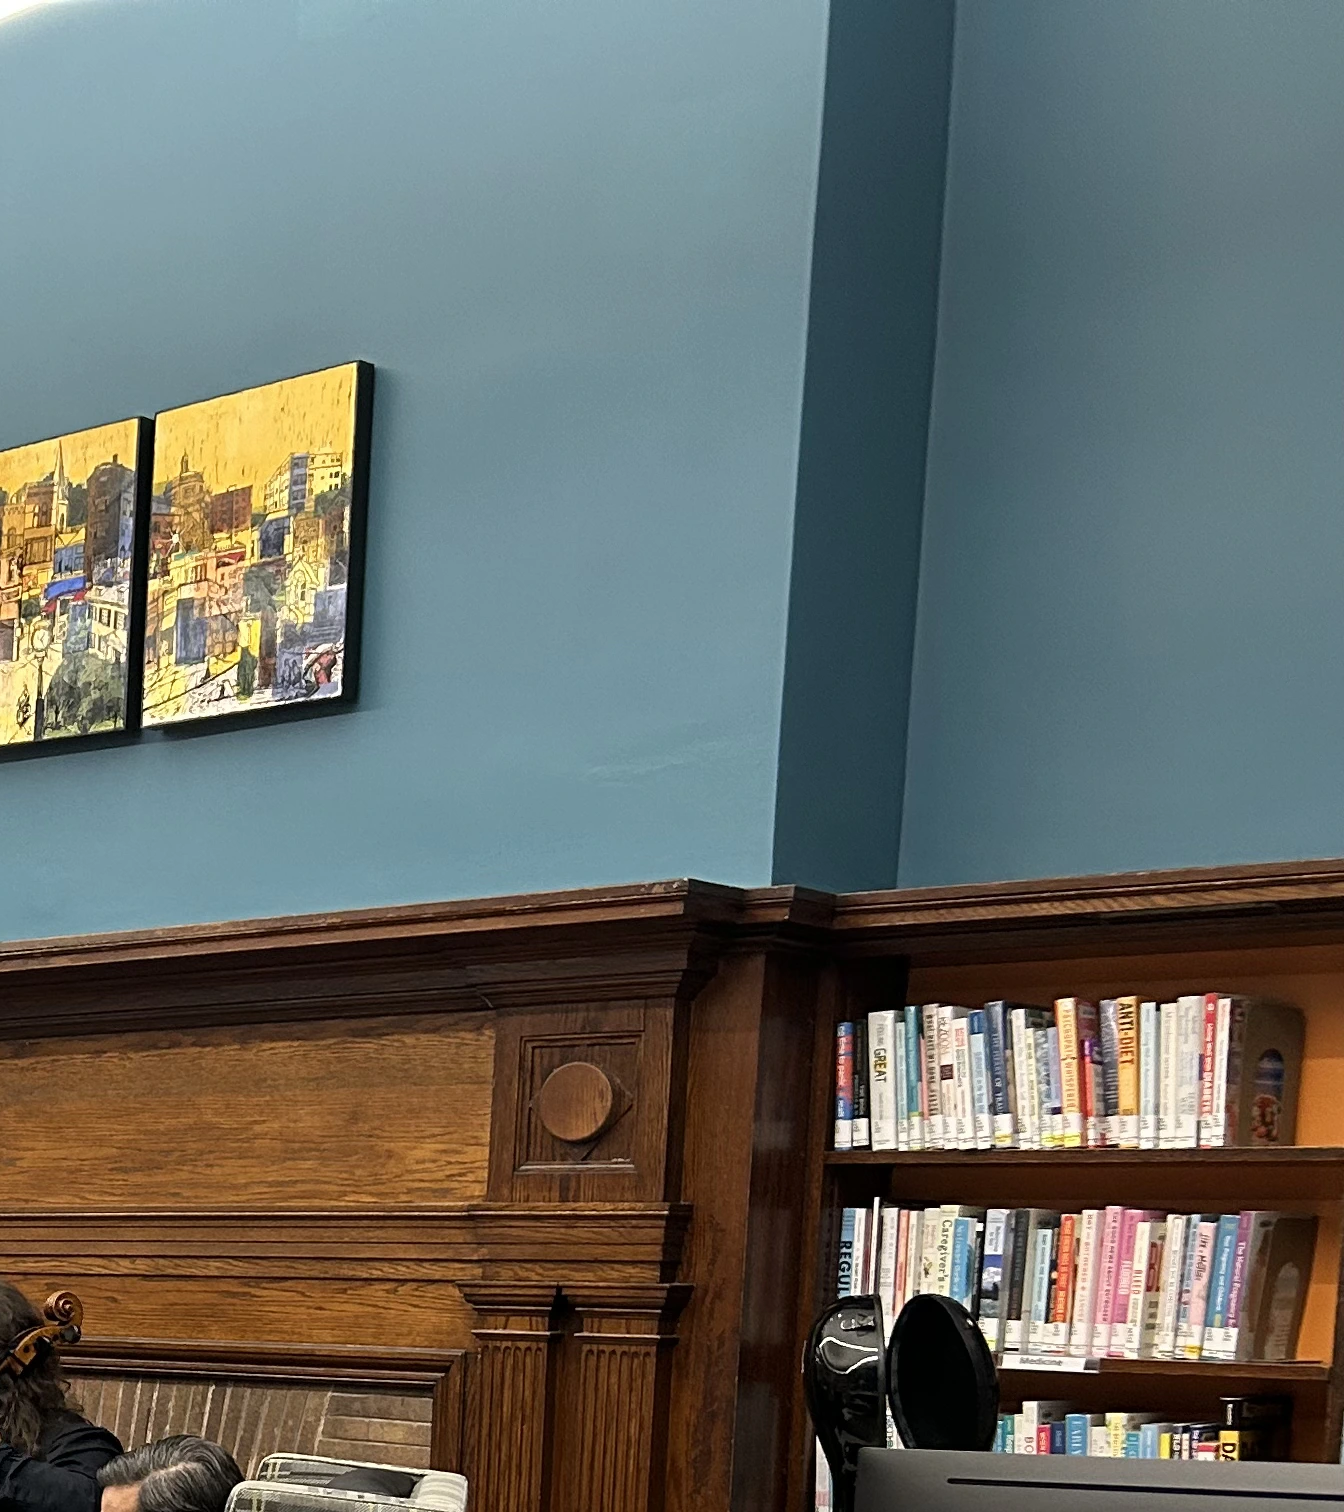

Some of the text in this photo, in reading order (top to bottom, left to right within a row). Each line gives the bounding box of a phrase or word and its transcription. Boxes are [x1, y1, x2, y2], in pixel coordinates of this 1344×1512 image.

[1118, 1002, 1135, 1065] ANTI-DIET
[873, 1048, 888, 1084] GREAT
[937, 1219, 953, 1282] Caregiver's
